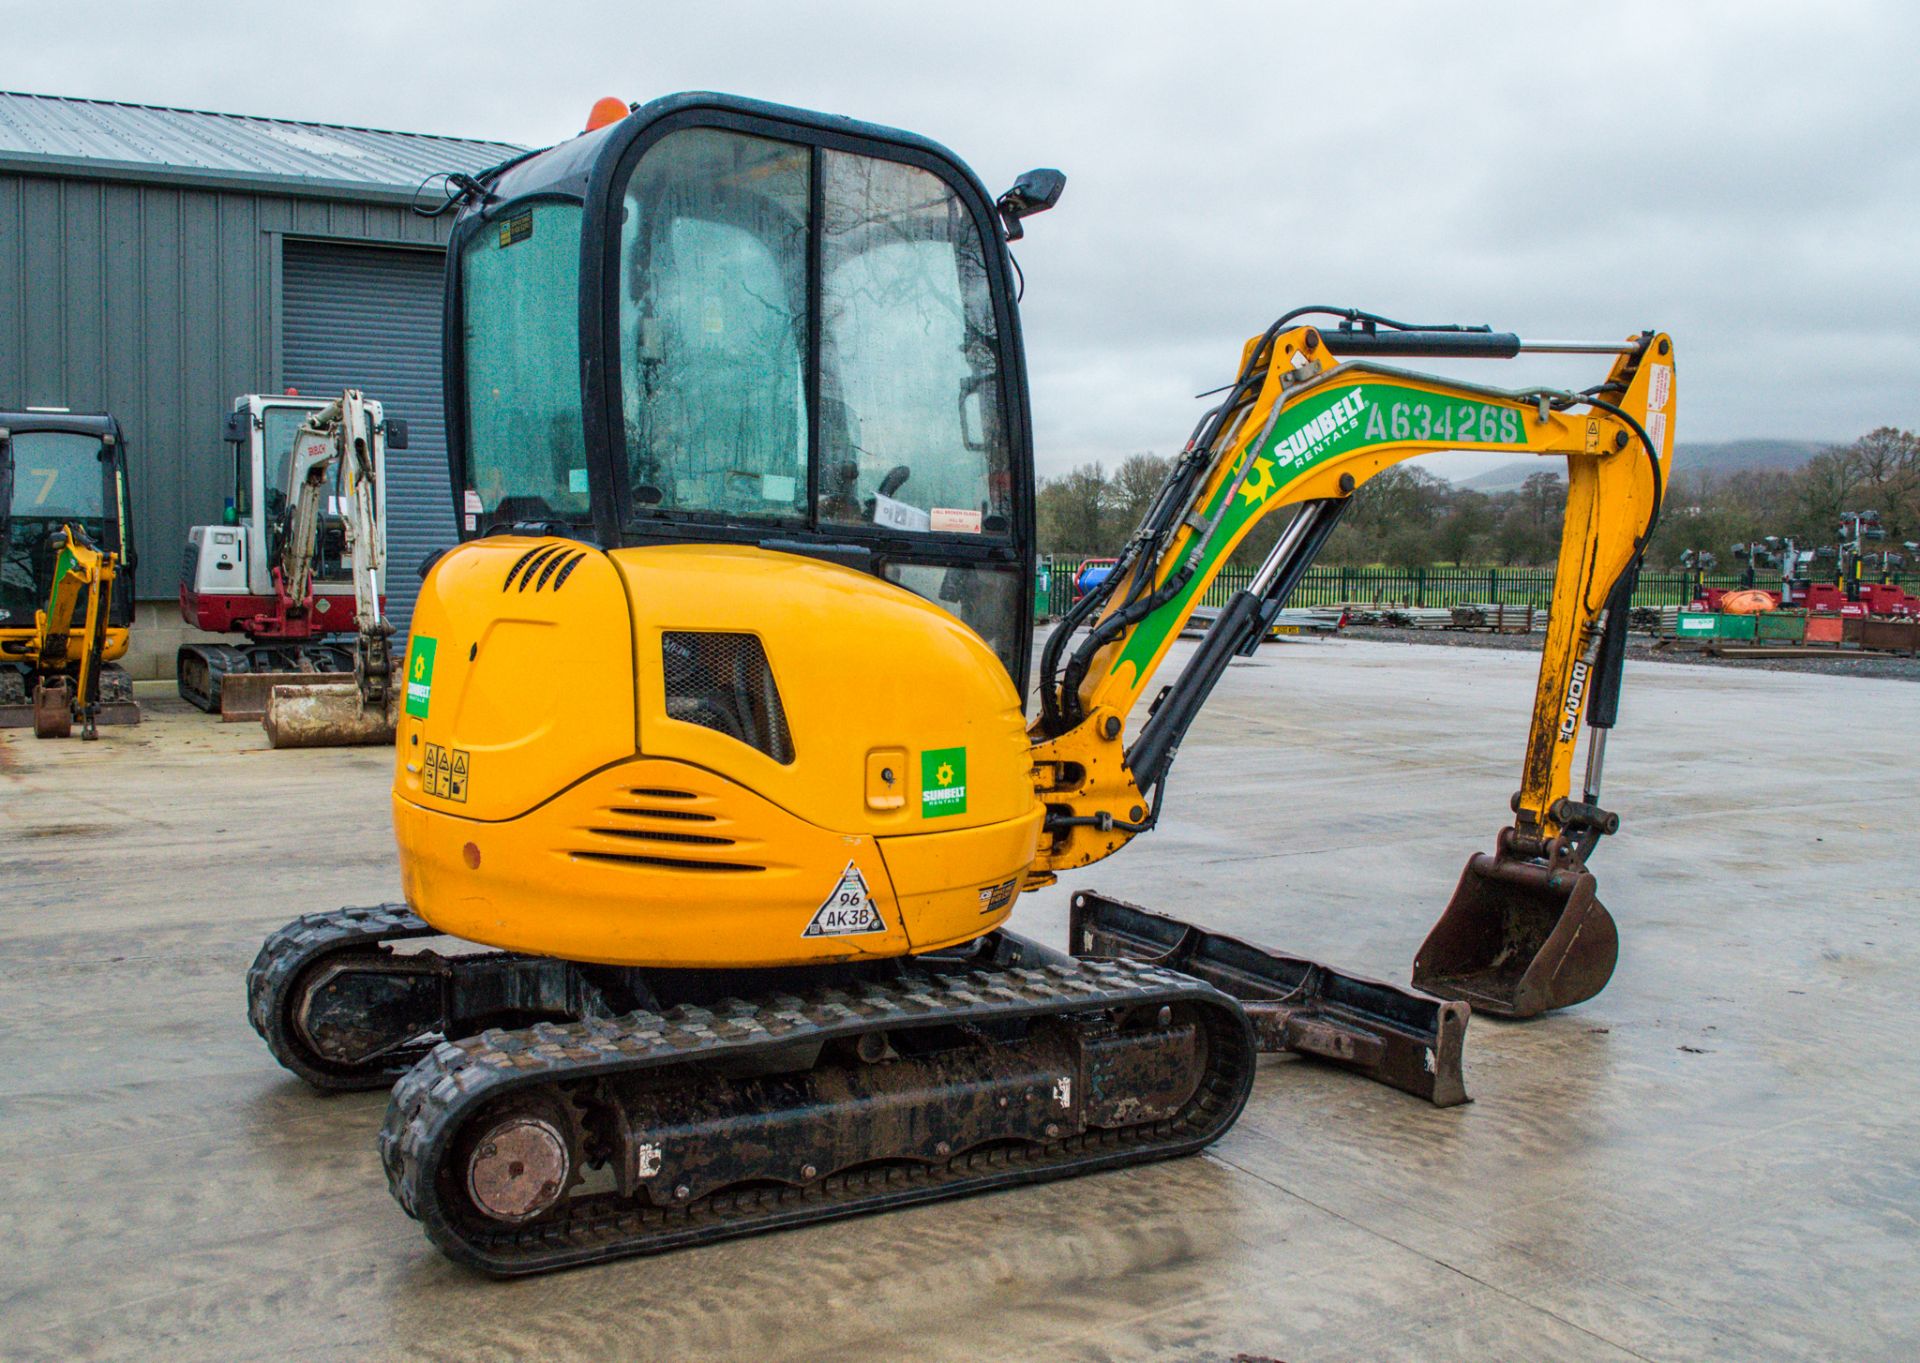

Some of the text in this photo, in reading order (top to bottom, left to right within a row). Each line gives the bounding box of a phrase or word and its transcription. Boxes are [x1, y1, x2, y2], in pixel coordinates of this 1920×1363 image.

[1274, 386, 1365, 467] SUNBELT
[1295, 418, 1359, 469] RENTALS
[31, 469, 58, 505] 7
[922, 786, 966, 802] SUNBELT
[840, 892, 860, 906] 96
